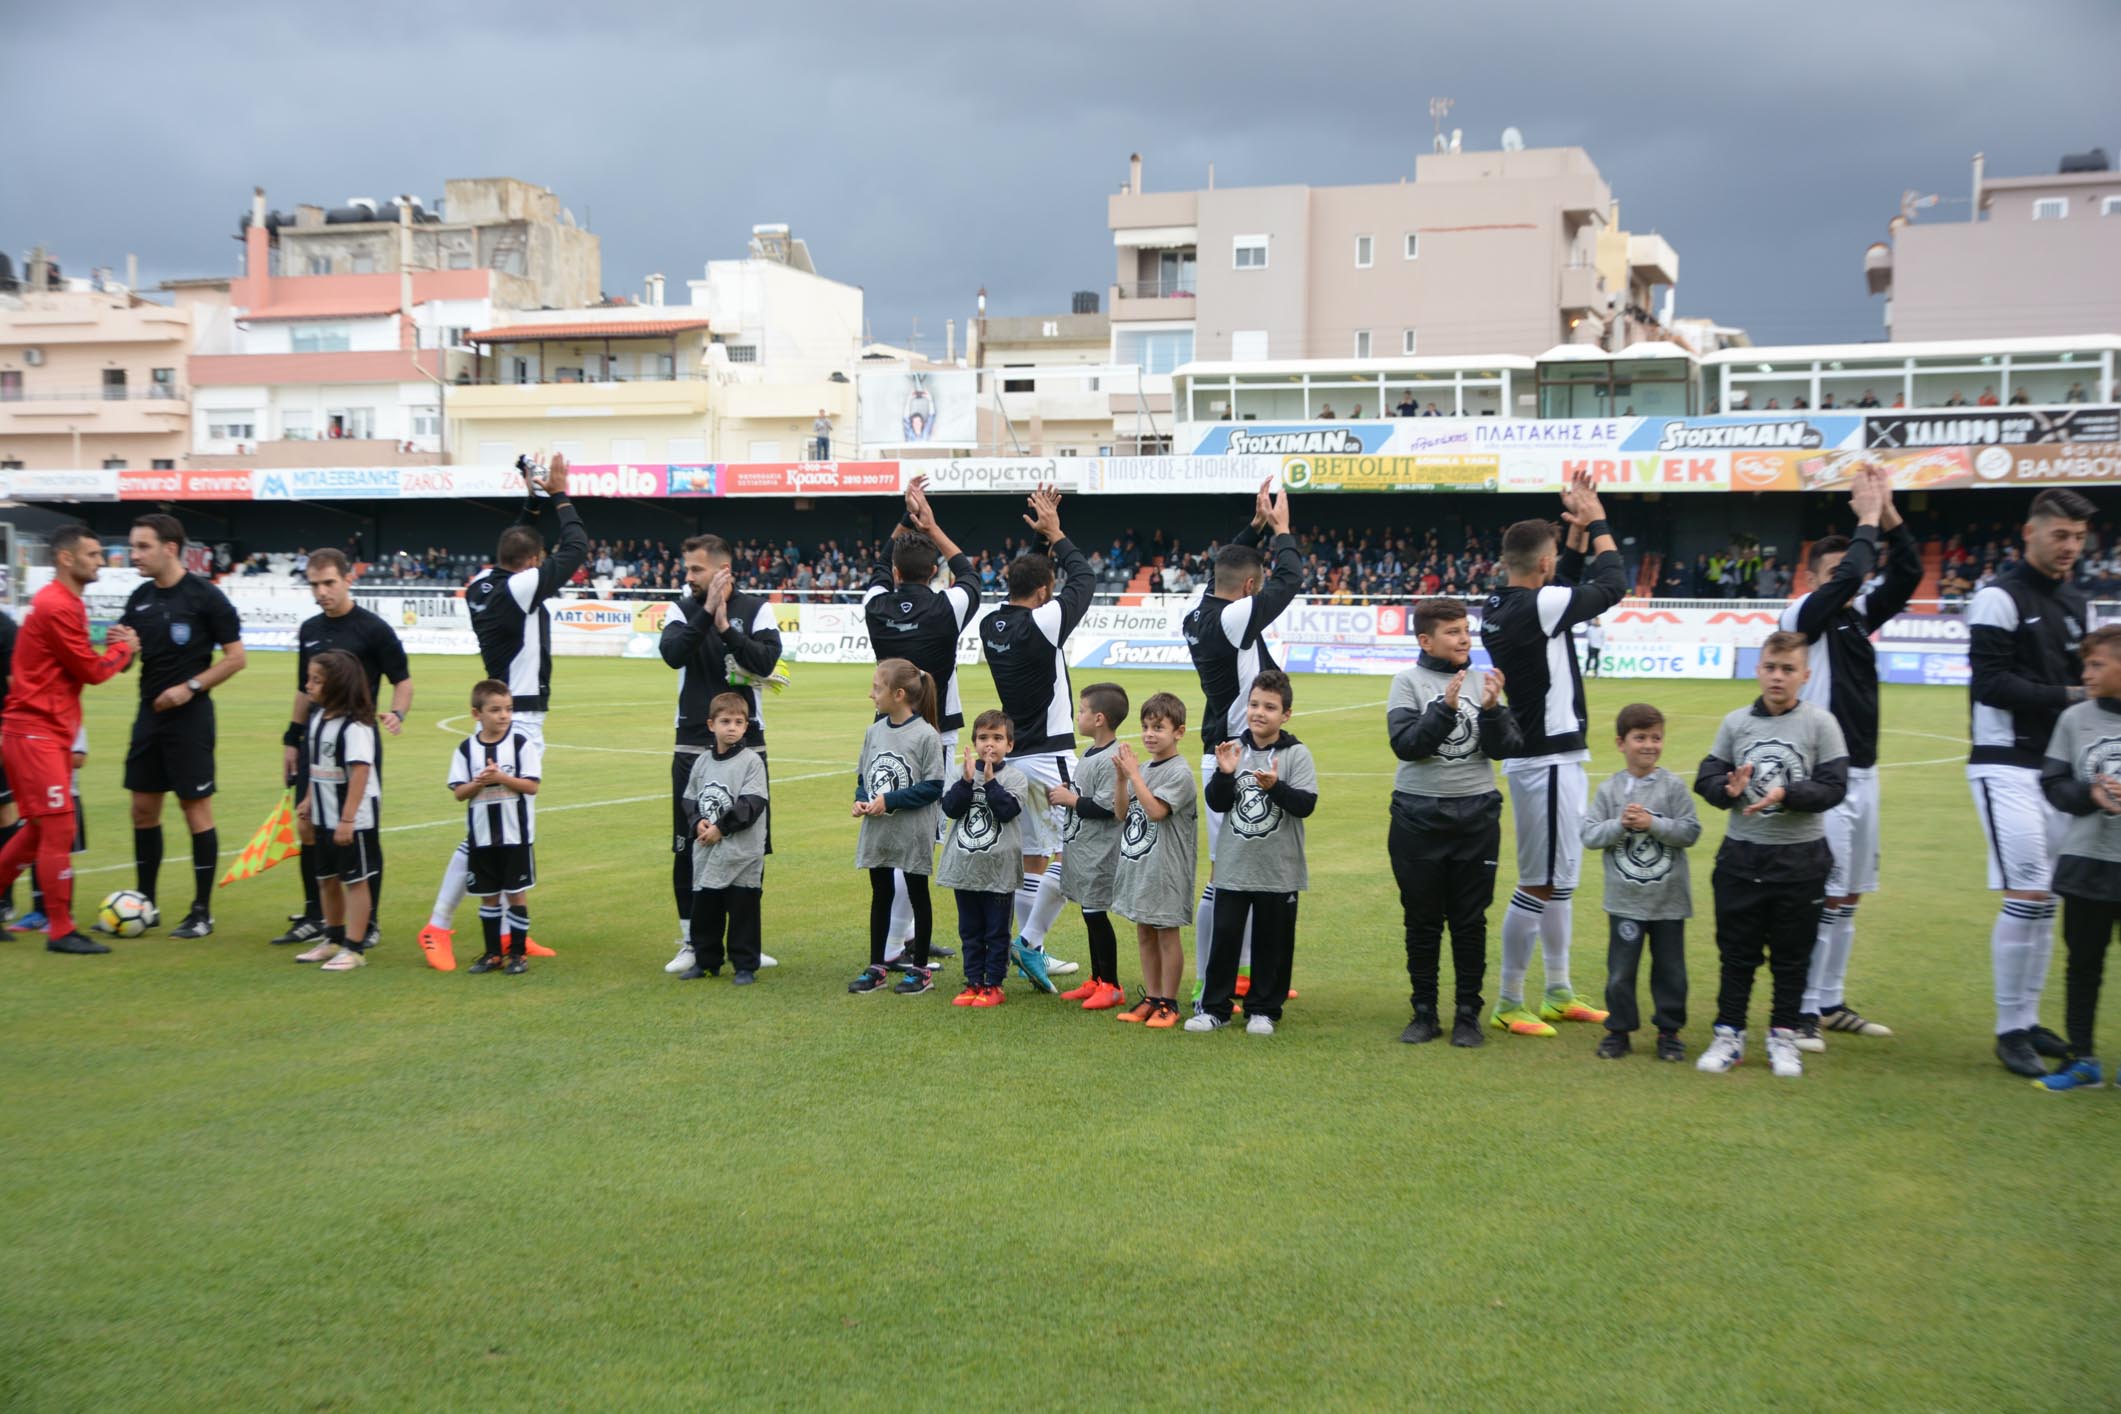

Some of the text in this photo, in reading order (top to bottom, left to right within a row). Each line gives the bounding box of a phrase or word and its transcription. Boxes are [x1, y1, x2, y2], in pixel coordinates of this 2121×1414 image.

[1226, 429, 1349, 454] STOIXIMAN
[1475, 424, 1617, 441] ΠΛΑΤΑΚΗΣ ΑΕ
[1658, 420, 1807, 451] STOIXIMAN
[1312, 456, 1416, 477] BETOLIT
[293, 471, 400, 486] ΜΠΑΞΕΒΑΝΗΣ
[567, 465, 658, 498] molto
[1112, 613, 1167, 630] Home
[1102, 641, 1193, 665] STOIXIM
[48, 785, 64, 808] 5
